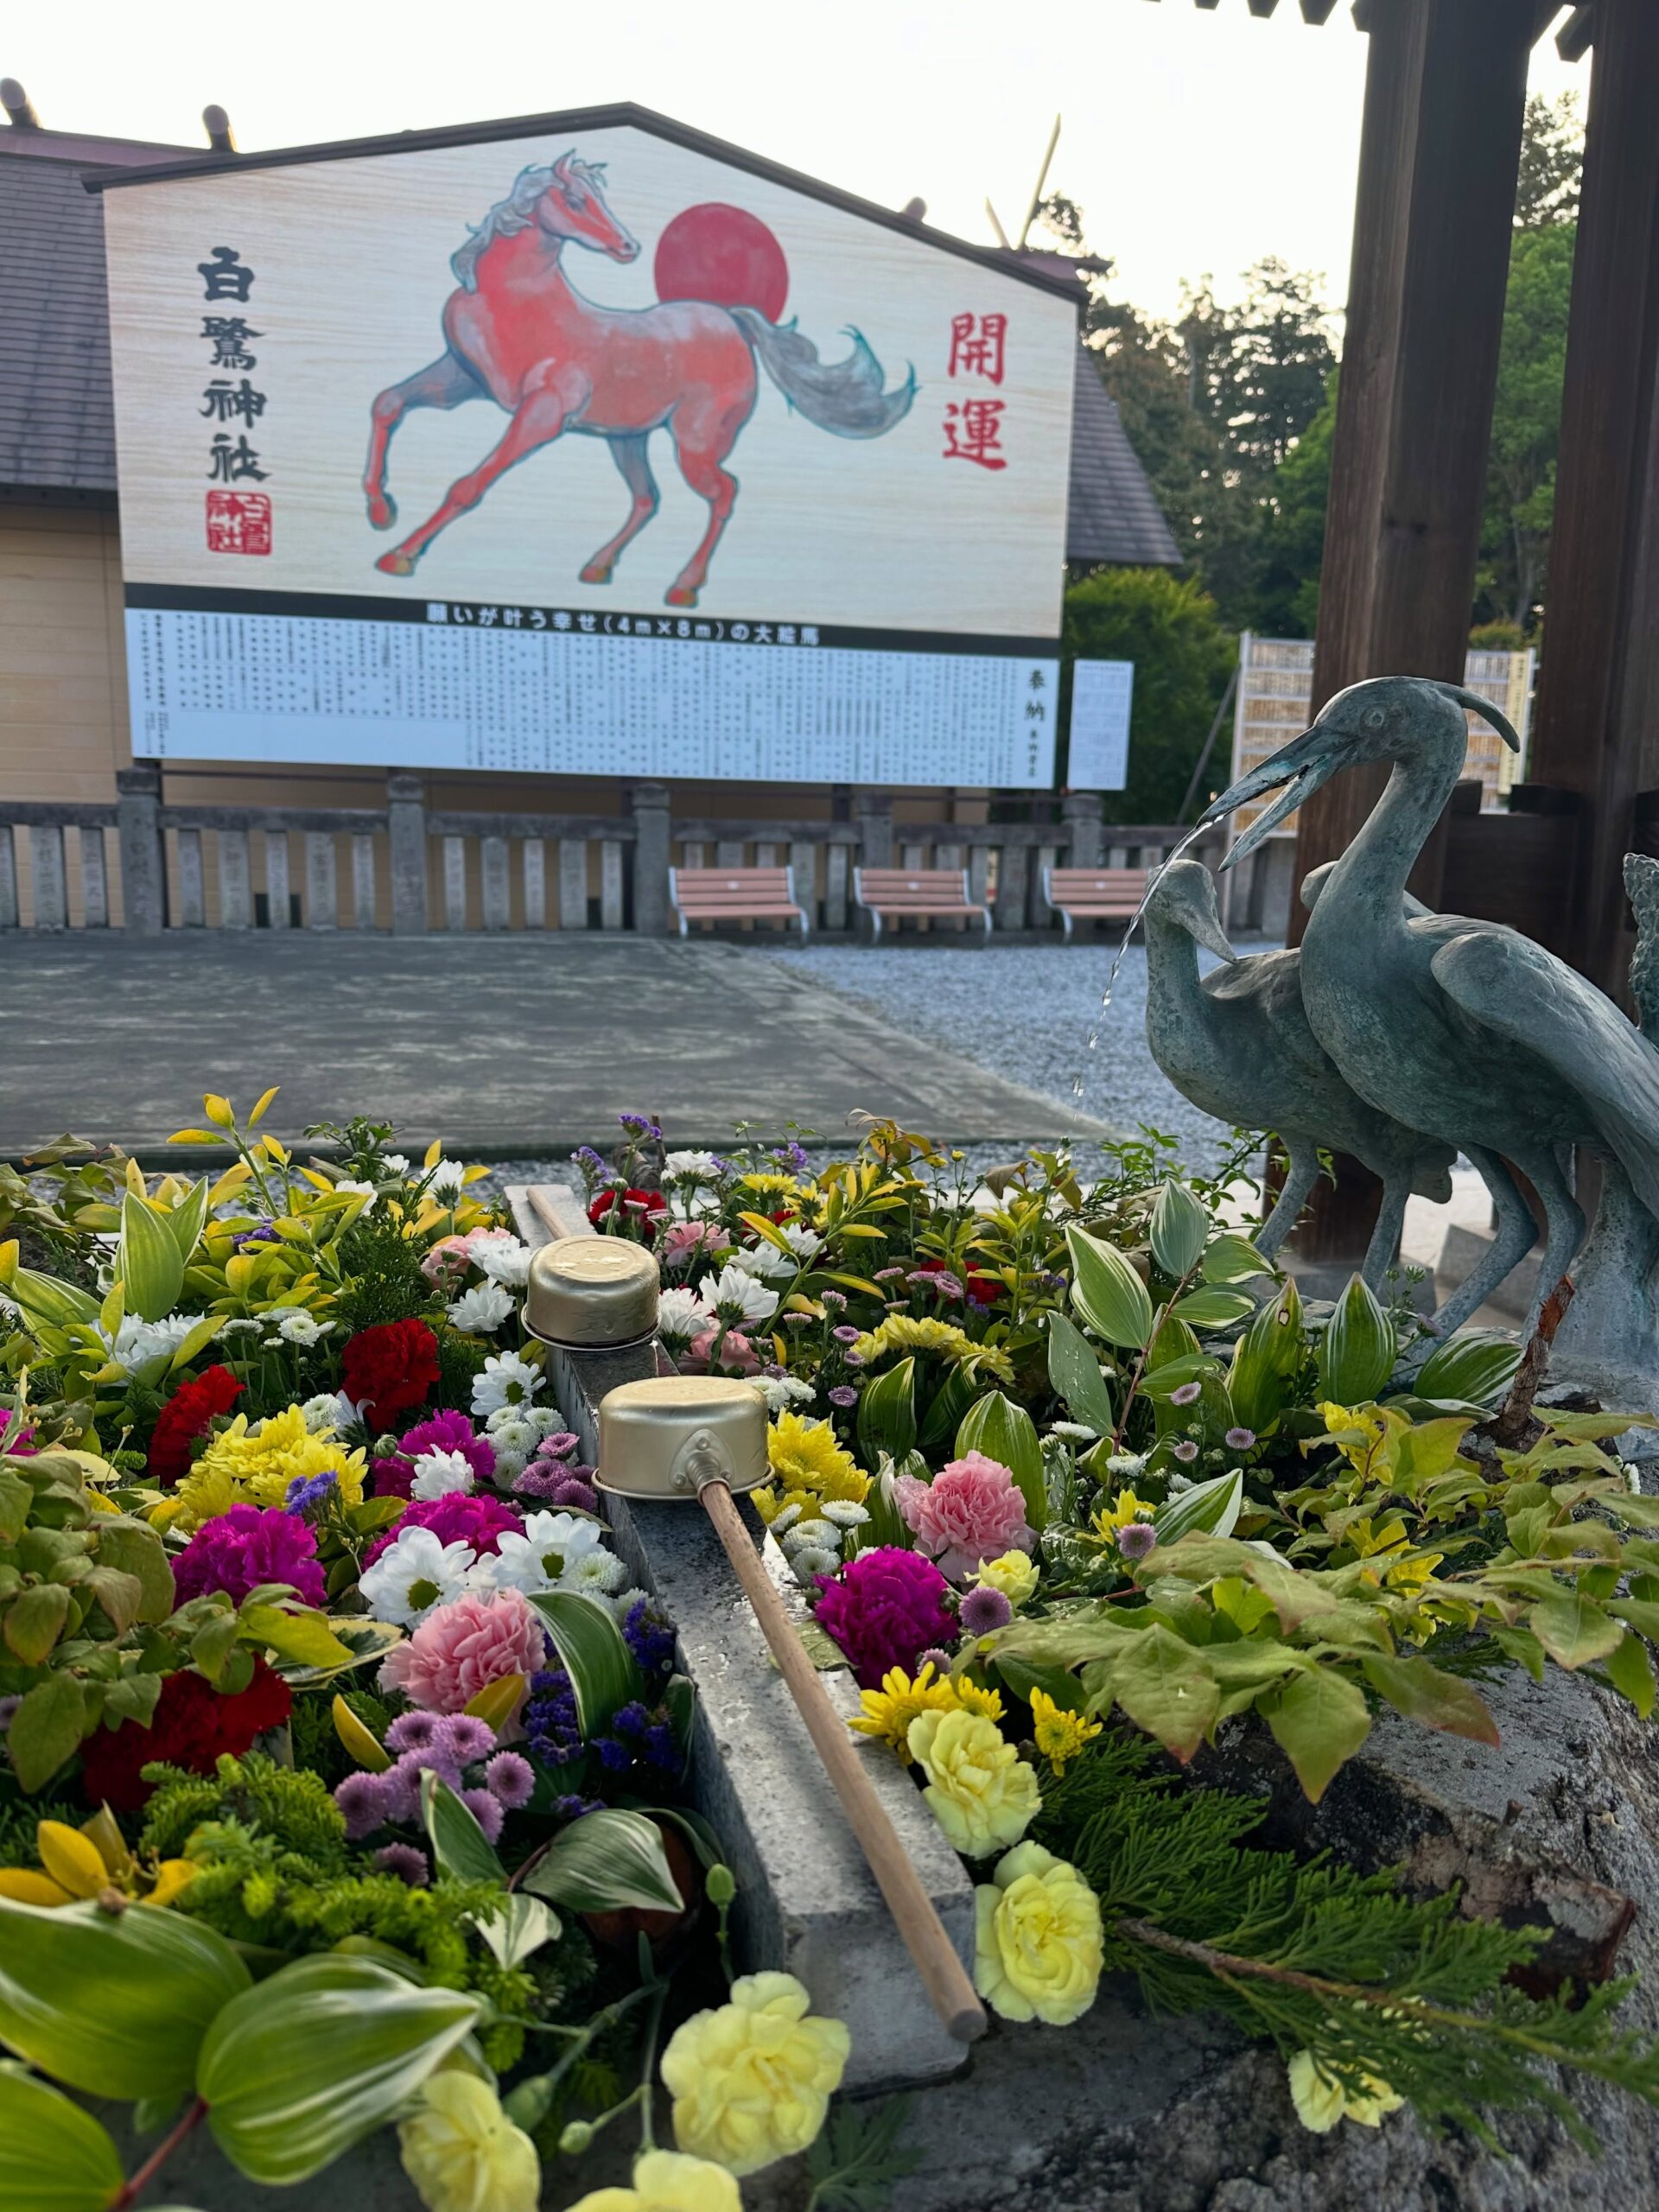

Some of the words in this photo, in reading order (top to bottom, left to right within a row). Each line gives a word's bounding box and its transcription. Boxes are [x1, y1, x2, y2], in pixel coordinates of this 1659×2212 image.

[198, 246, 272, 483] 白鷺神社
[943, 313, 1007, 471] 開運
